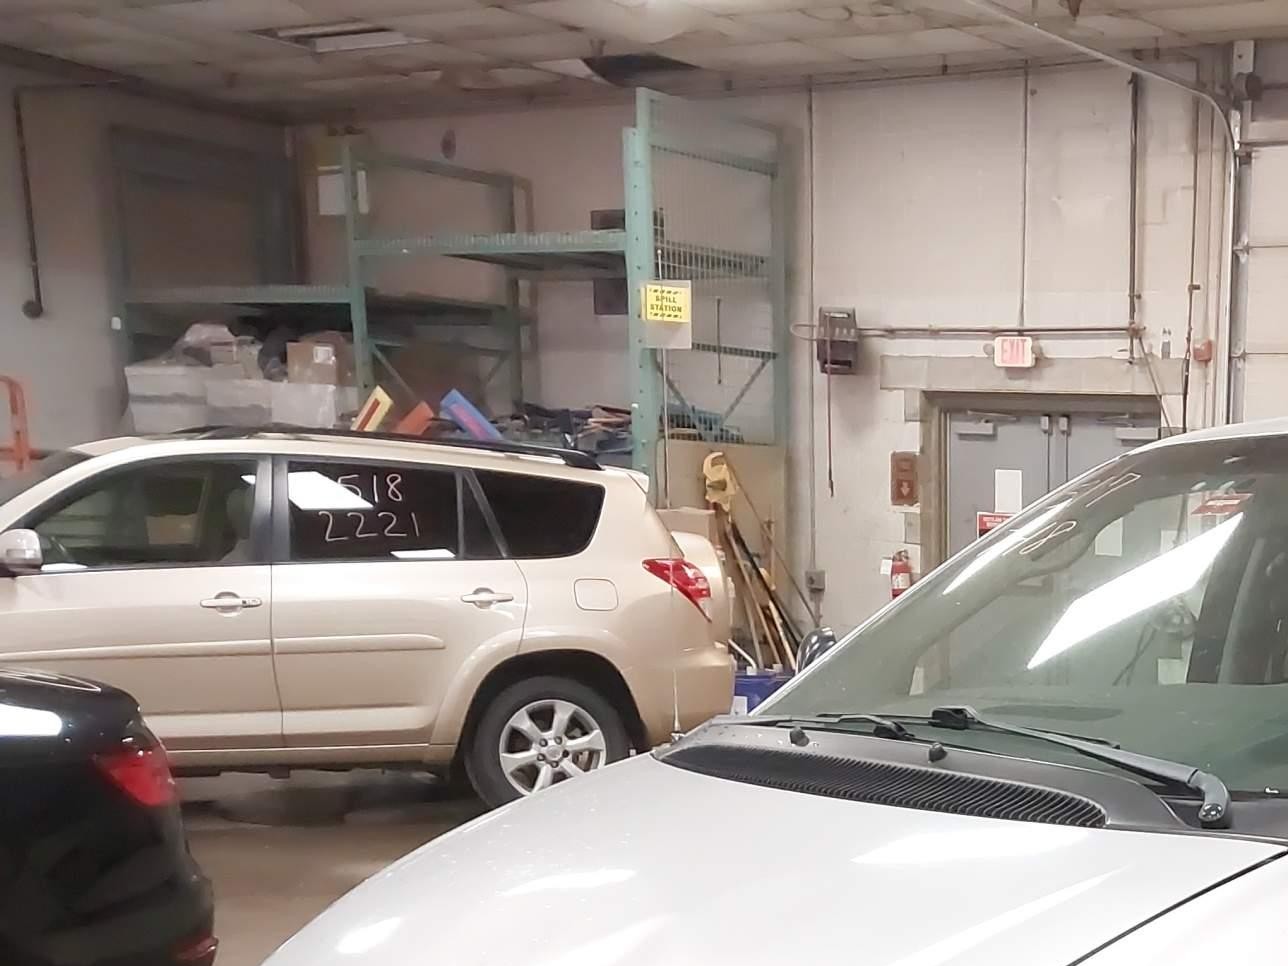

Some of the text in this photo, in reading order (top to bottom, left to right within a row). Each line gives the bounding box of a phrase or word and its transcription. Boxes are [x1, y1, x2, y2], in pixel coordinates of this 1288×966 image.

[650, 303, 682, 313] STATION
[655, 295, 678, 304] SPILL
[1001, 338, 1027, 365] EXIT
[318, 510, 420, 542] 2221
